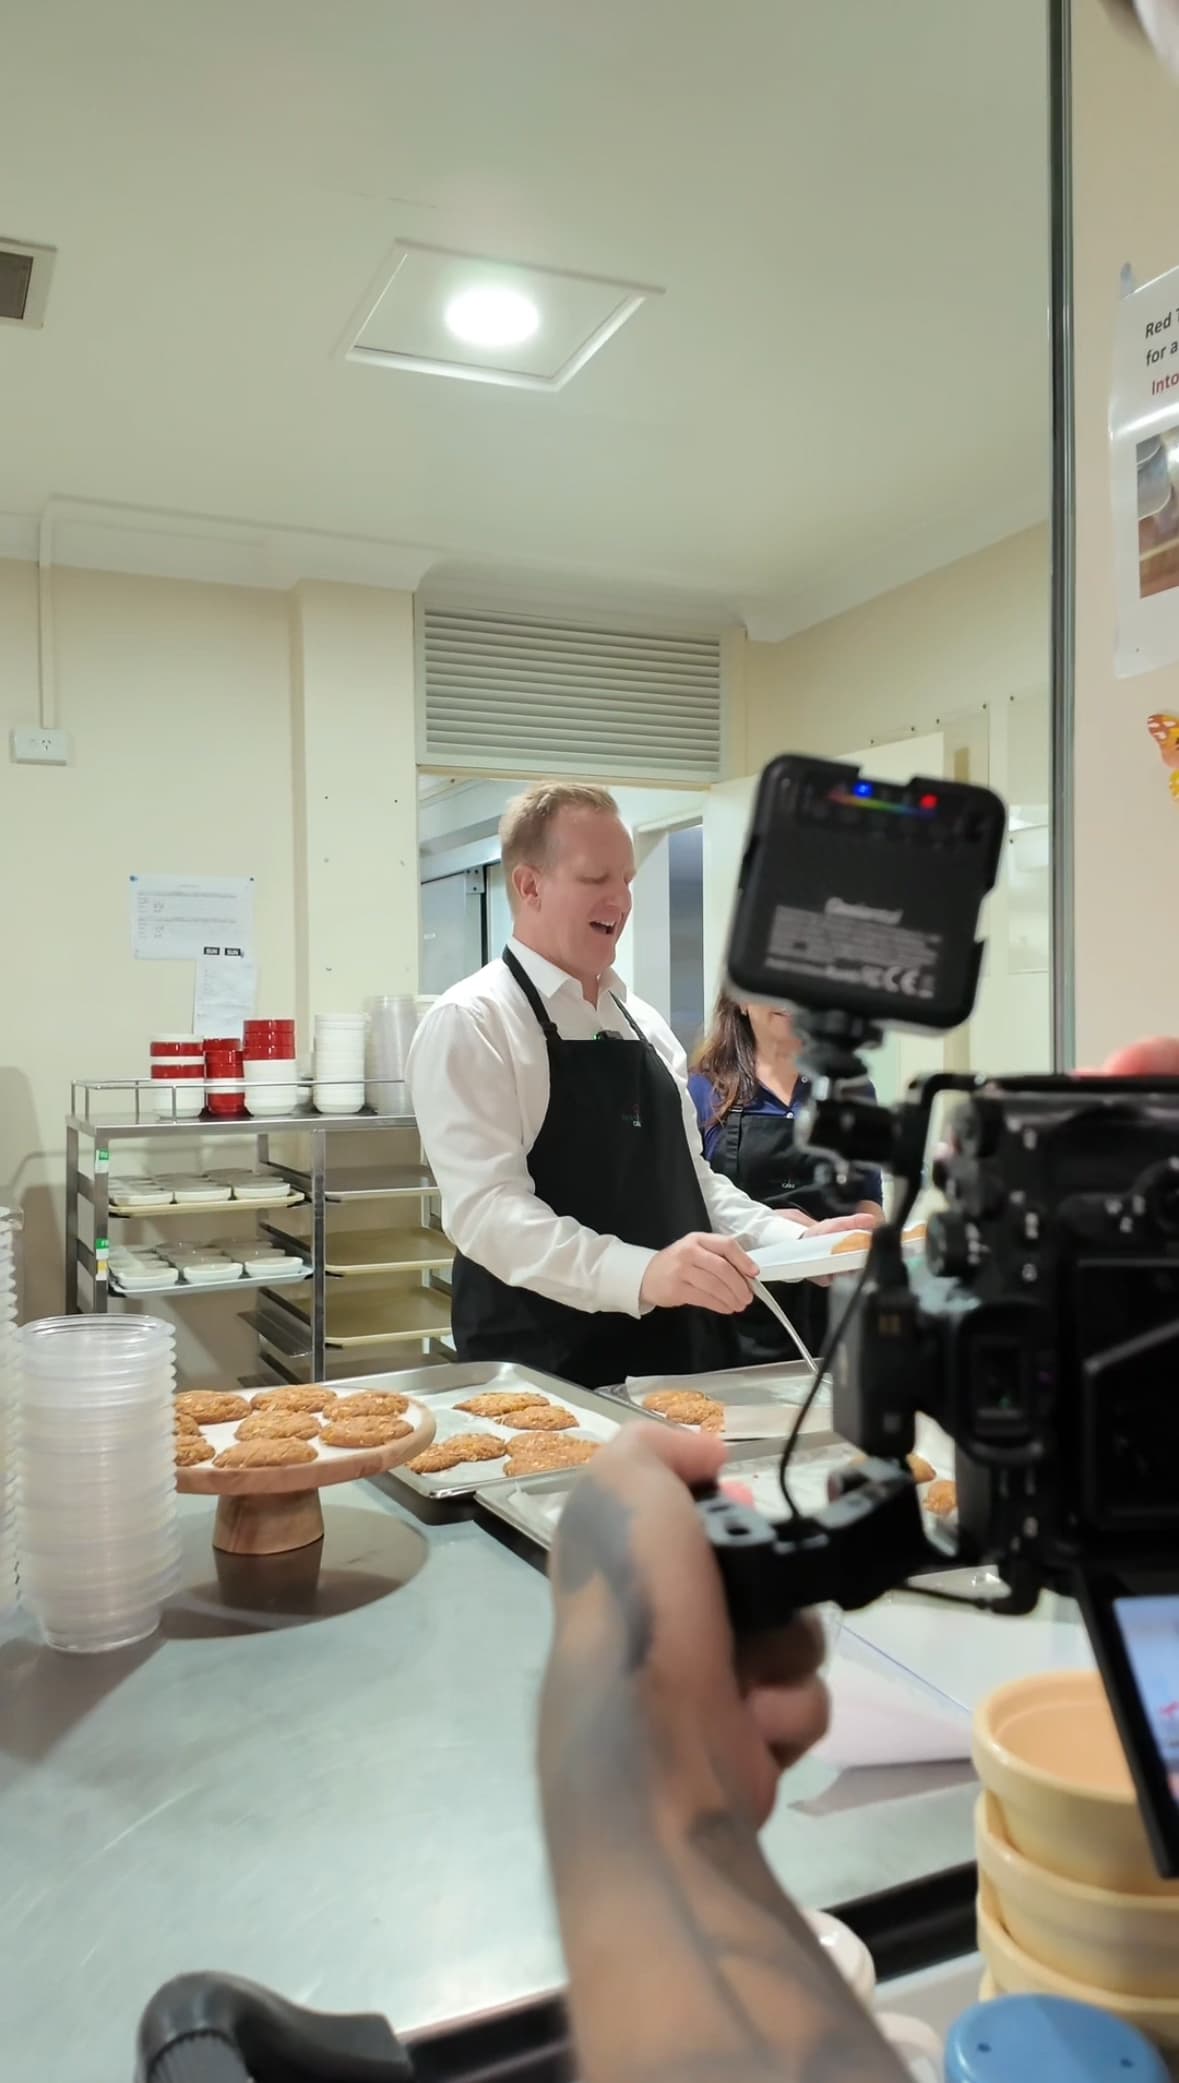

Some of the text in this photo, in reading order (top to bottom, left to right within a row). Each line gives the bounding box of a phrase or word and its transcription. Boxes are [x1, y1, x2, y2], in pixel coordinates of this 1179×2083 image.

[1145, 311, 1172, 339] Red
[1146, 348, 1167, 367] for
[1152, 373, 1179, 396] Into
